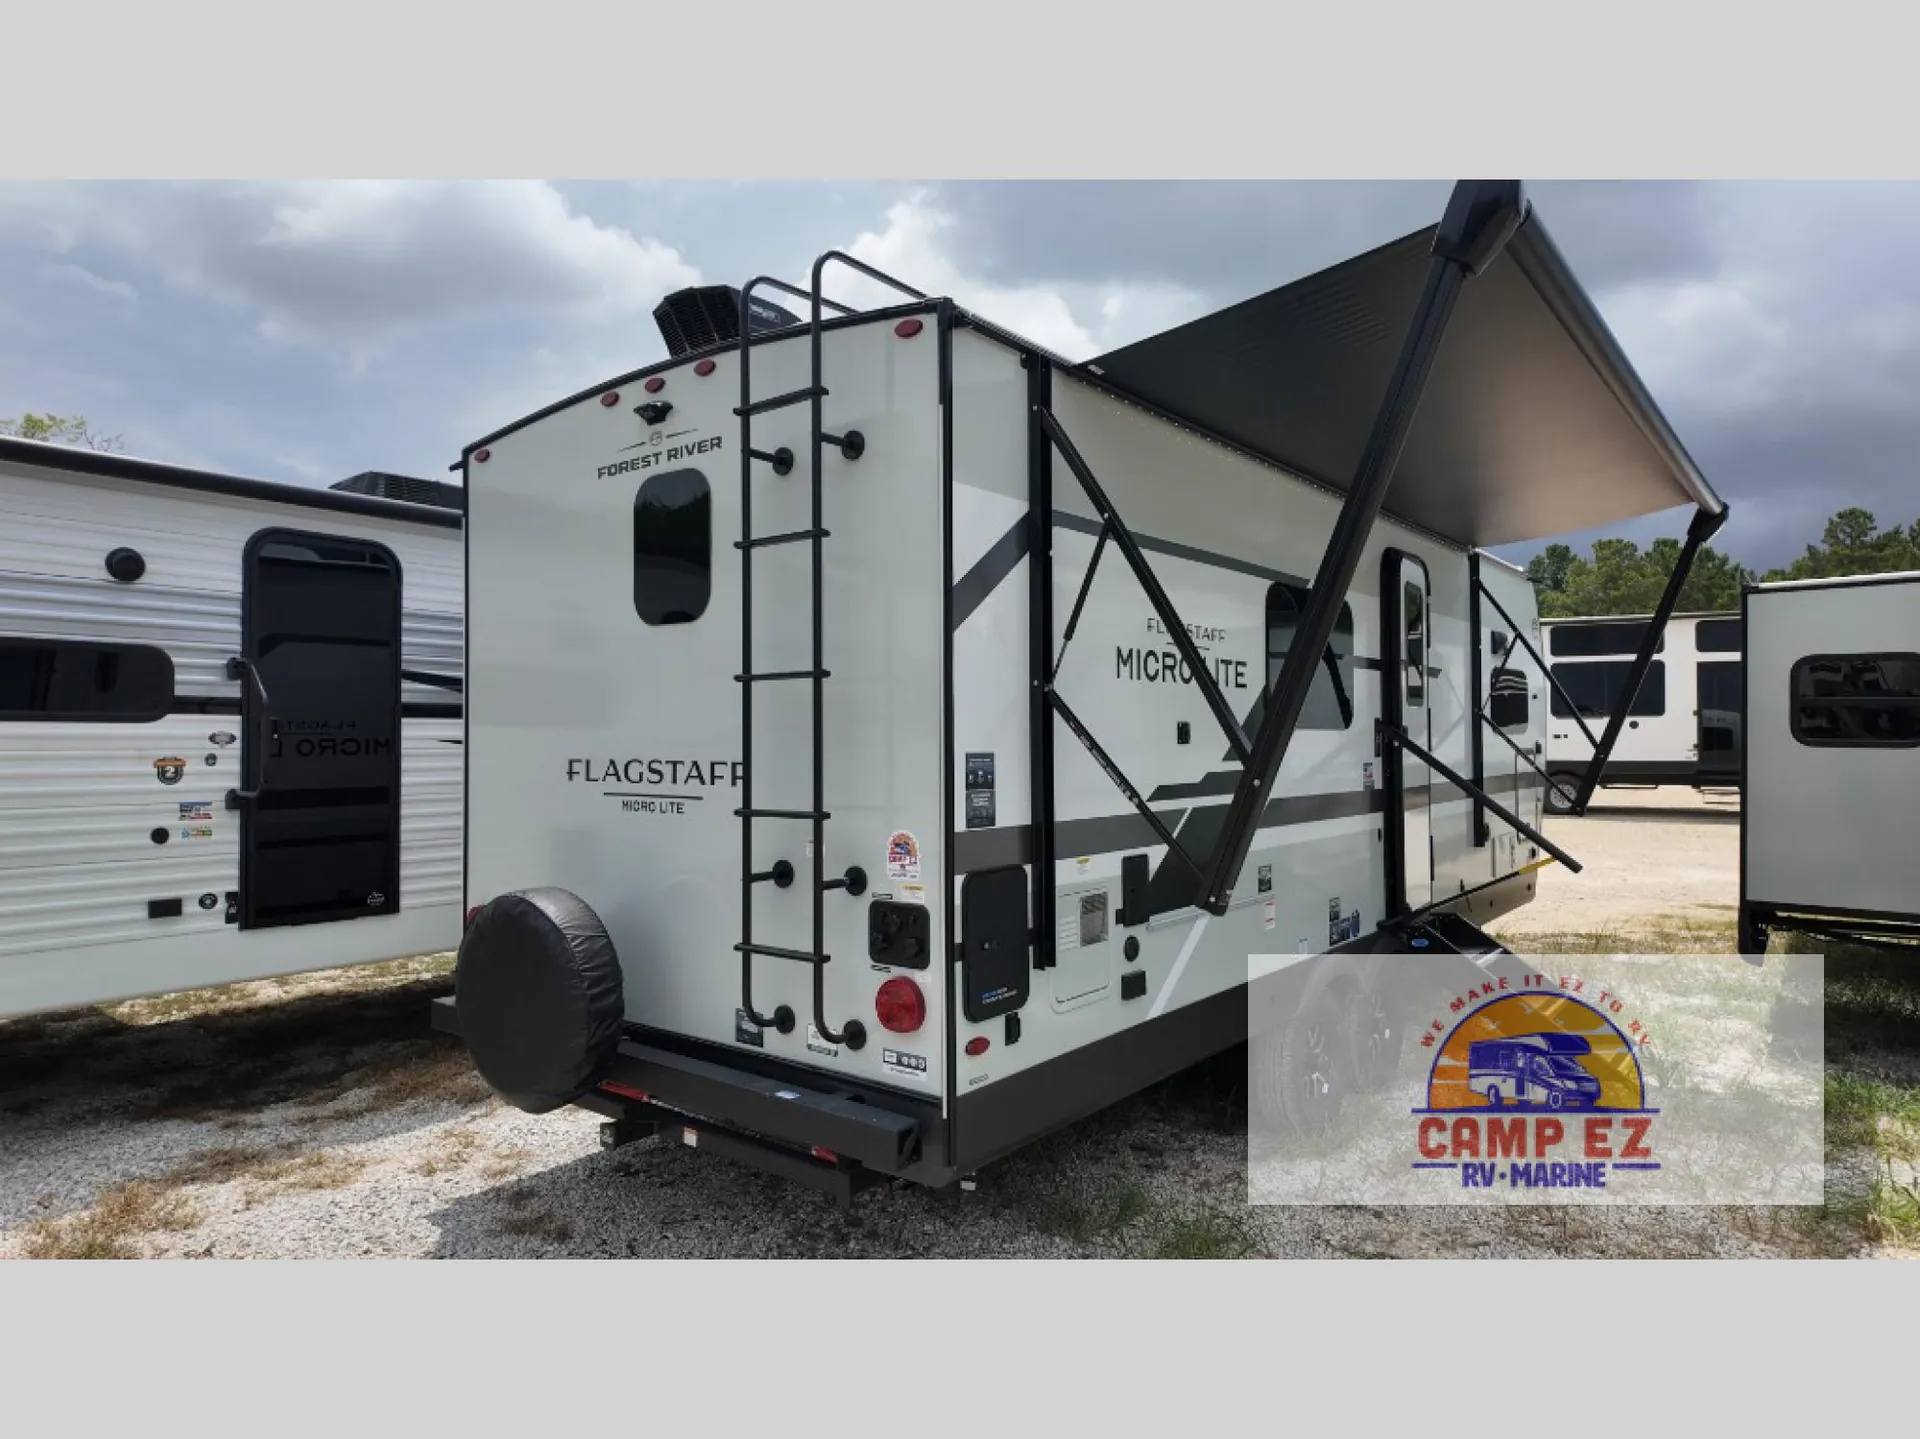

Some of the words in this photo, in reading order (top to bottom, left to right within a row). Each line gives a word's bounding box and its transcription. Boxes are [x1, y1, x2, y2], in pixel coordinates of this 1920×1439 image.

[597, 451, 663, 480] FOREST
[667, 436, 722, 461] RIVER
[1147, 618, 1226, 642] FLSTAFF
[1116, 645, 1191, 684] MICRO
[566, 758, 743, 787] FLAGSTAFF
[622, 800, 656, 814] MICRO
[659, 801, 685, 814] LITE
